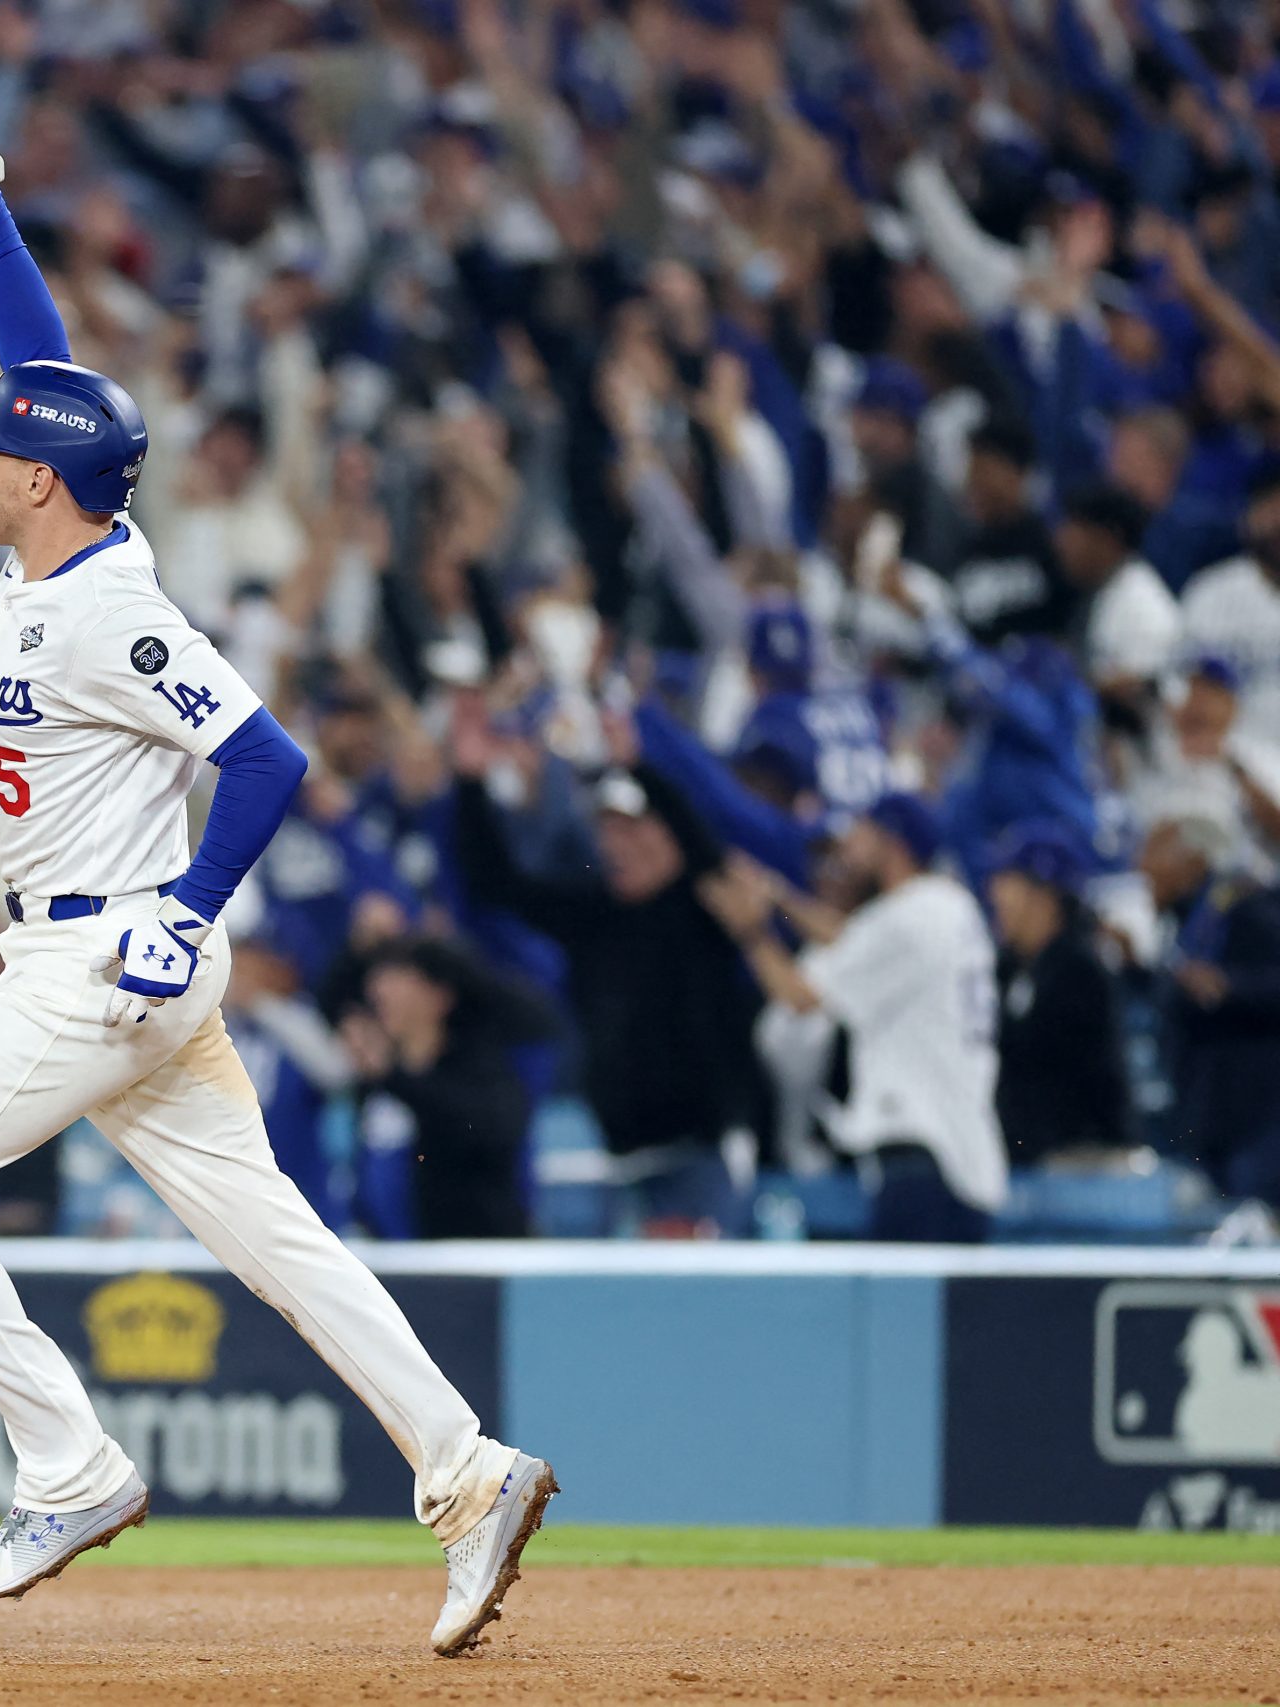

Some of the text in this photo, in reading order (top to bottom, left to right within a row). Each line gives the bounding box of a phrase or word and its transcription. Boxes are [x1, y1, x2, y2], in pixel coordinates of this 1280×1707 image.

[30, 404, 97, 434] STRAUSS
[123, 487, 136, 508] 5
[139, 645, 165, 670] 34
[152, 681, 221, 730] LA
